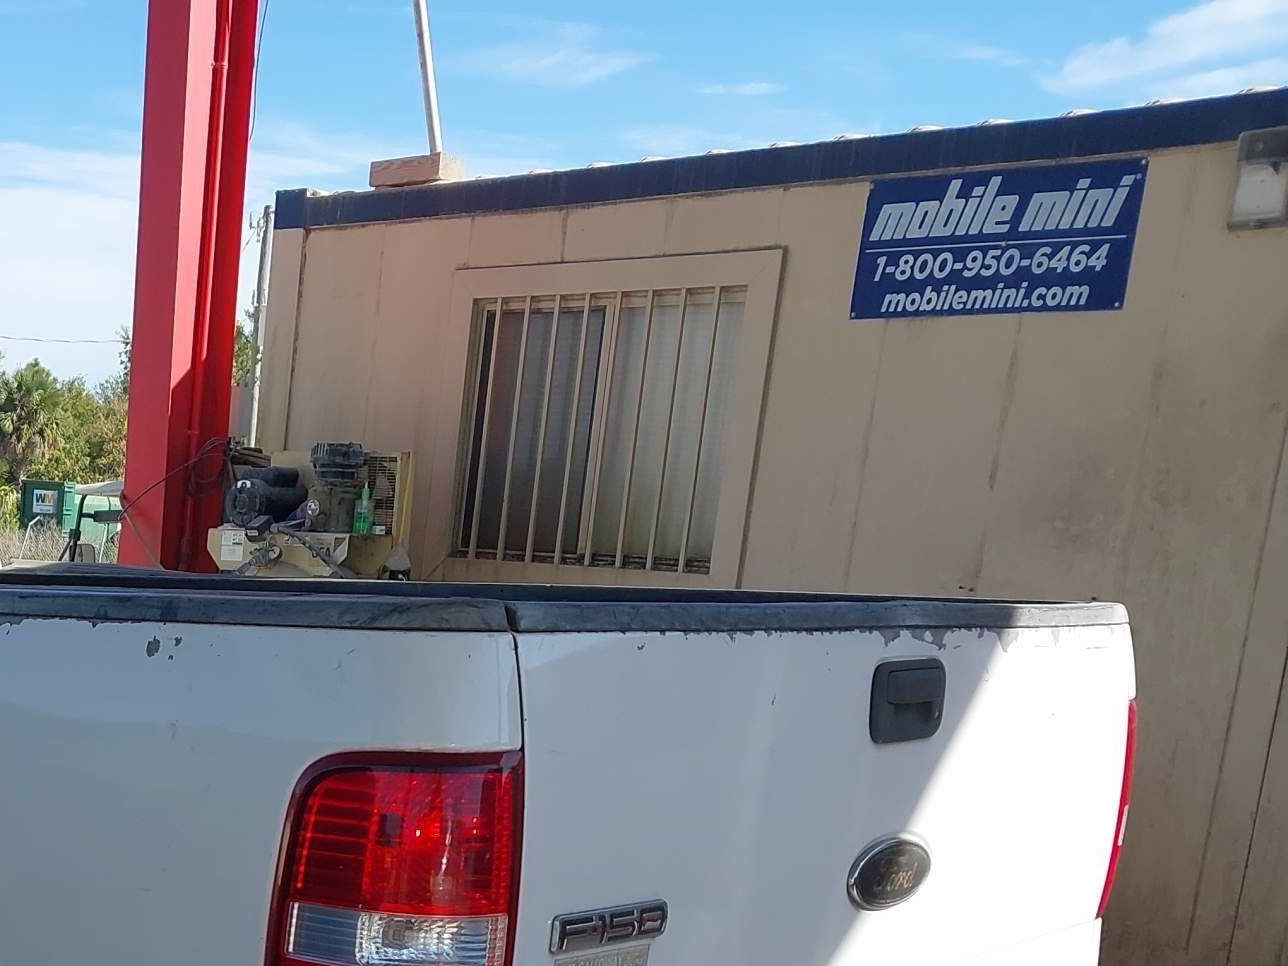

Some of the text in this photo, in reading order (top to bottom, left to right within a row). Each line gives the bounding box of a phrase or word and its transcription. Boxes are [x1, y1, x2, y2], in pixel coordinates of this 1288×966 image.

[869, 174, 1136, 241] mobile mini
[873, 243, 1111, 282] 1-800-950-6464
[880, 281, 1090, 313] mobilemini.com
